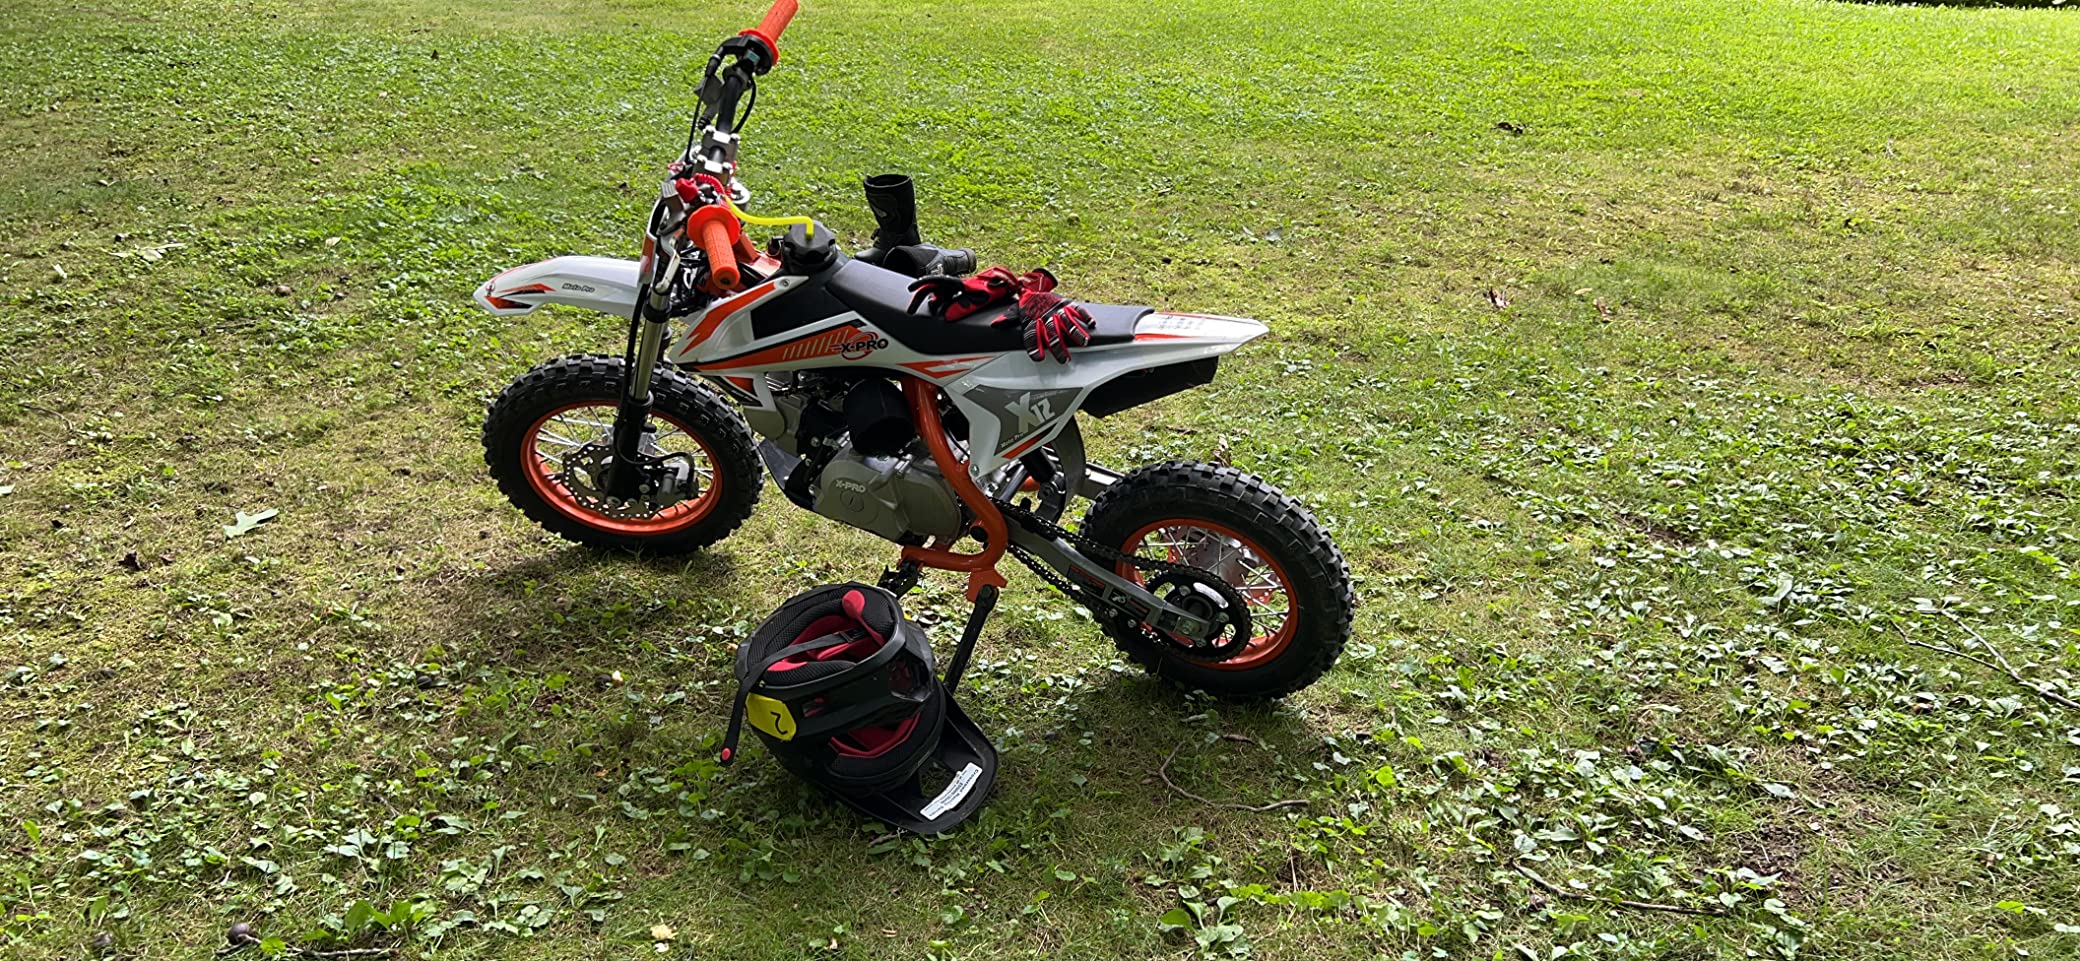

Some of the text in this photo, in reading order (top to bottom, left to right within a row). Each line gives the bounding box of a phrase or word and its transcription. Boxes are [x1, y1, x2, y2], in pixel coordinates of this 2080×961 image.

[840, 338, 889, 353] X-PRO
[1004, 391, 1056, 434] X12
[835, 479, 866, 493] X-PRO
